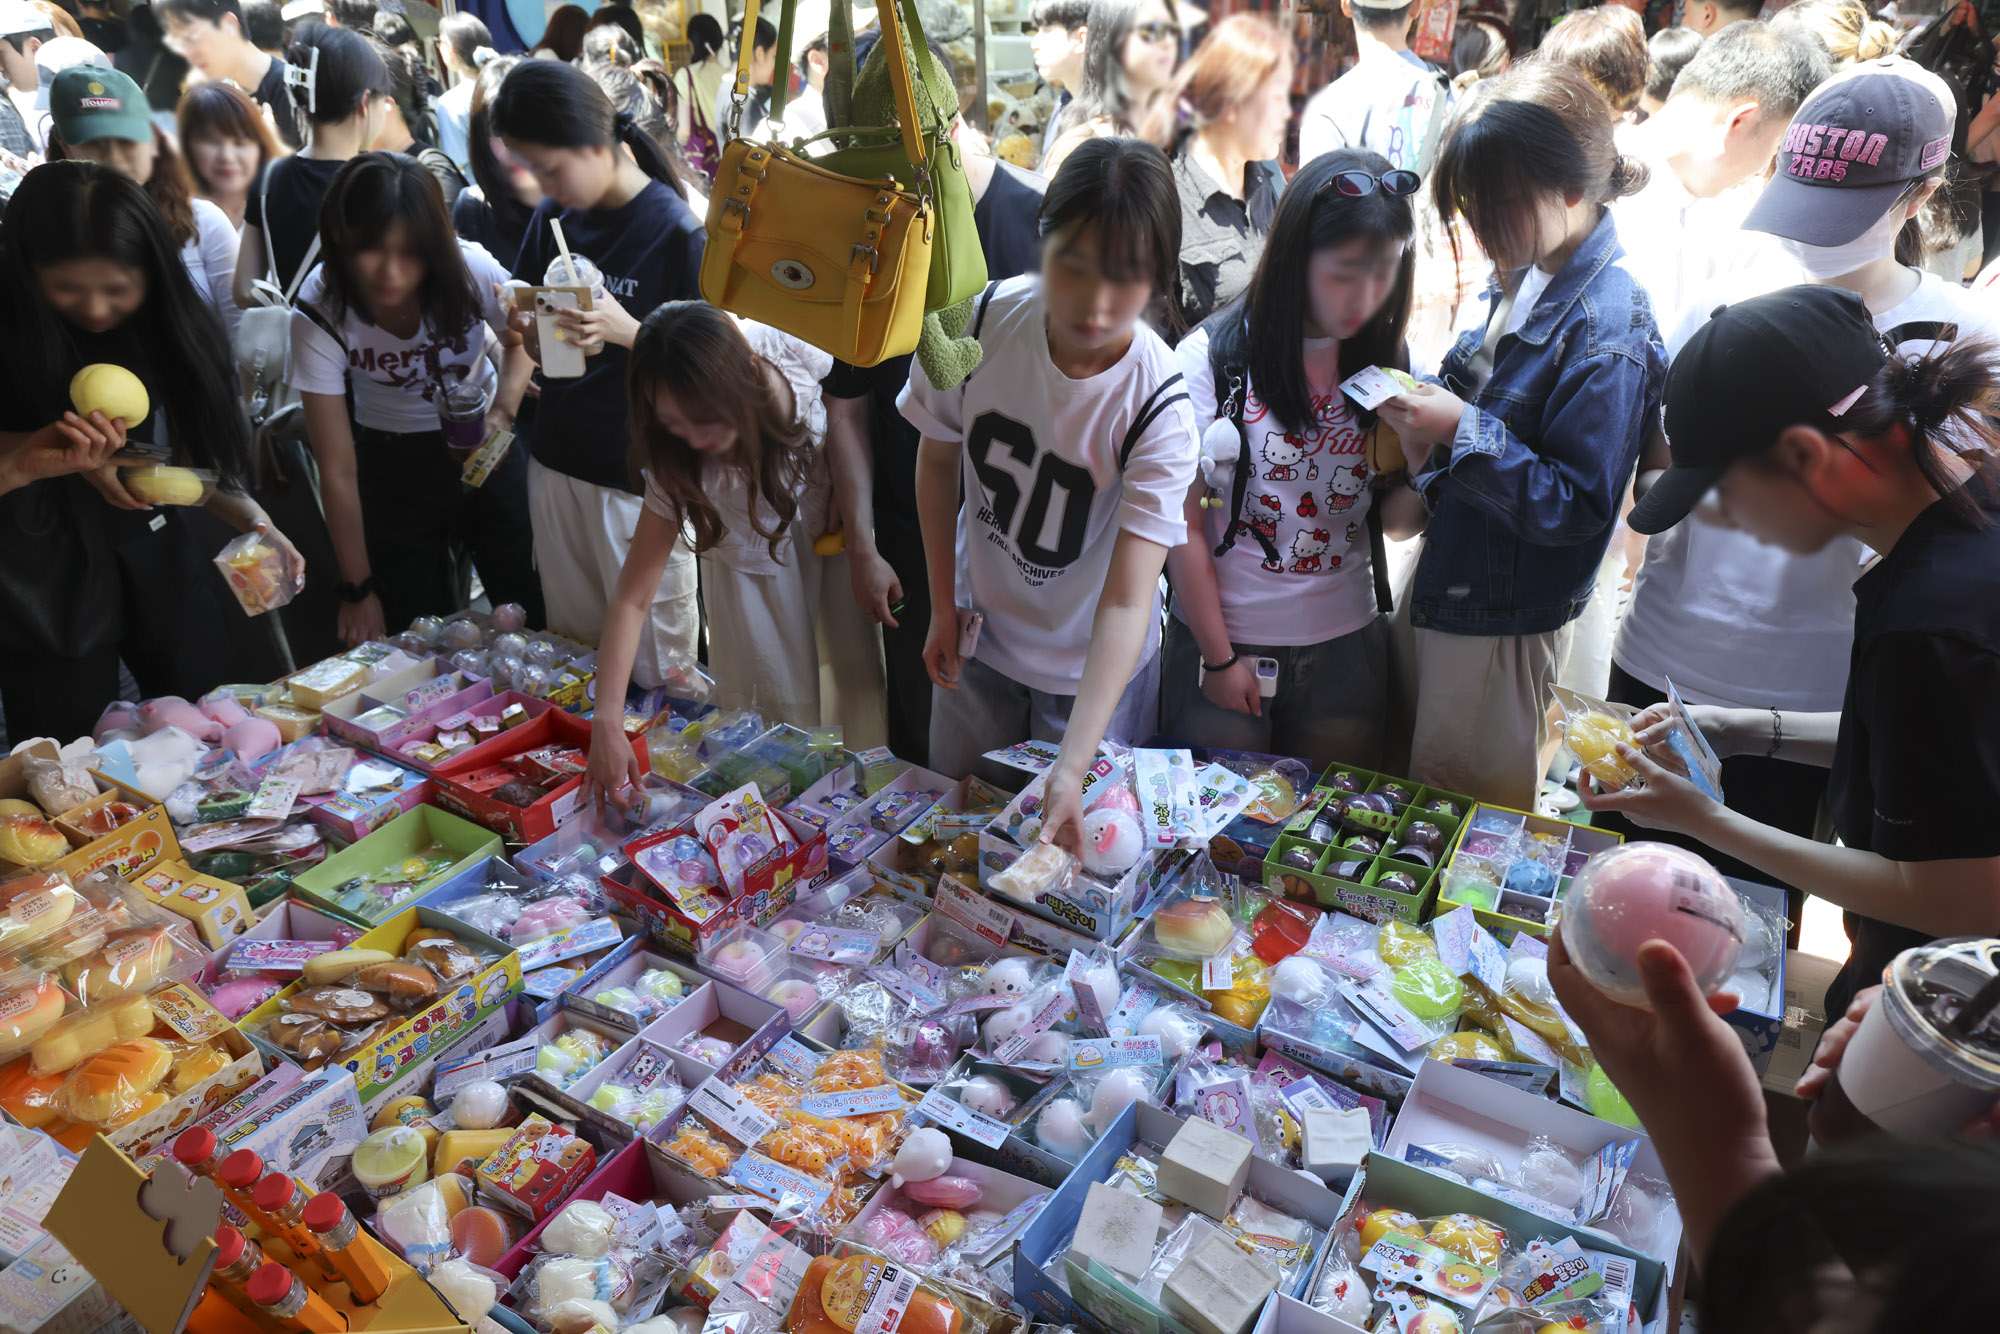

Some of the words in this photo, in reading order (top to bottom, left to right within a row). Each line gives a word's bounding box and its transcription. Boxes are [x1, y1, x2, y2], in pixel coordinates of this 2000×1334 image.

[1783, 123, 1888, 166] BOSTON
[1304, 426, 1368, 457] Kitt
[1336, 887, 1409, 912] 두바이쫀득쿠키
[413, 1004, 448, 1033] 안전
[397, 1001, 479, 1067] 고무야구공
[1123, 1039, 1158, 1053] 말랑뽀송
[1108, 1046, 1160, 1063] 물개말랑이
[256, 1078, 330, 1123] 쿠키하우스
[811, 1095, 844, 1111] 말랑이
[845, 1092, 889, 1106] 미니물고기
[745, 1160, 775, 1183] 말랑이
[774, 1174, 818, 1198] 미니물고기
[861, 1262, 881, 1292] 스퀴시
